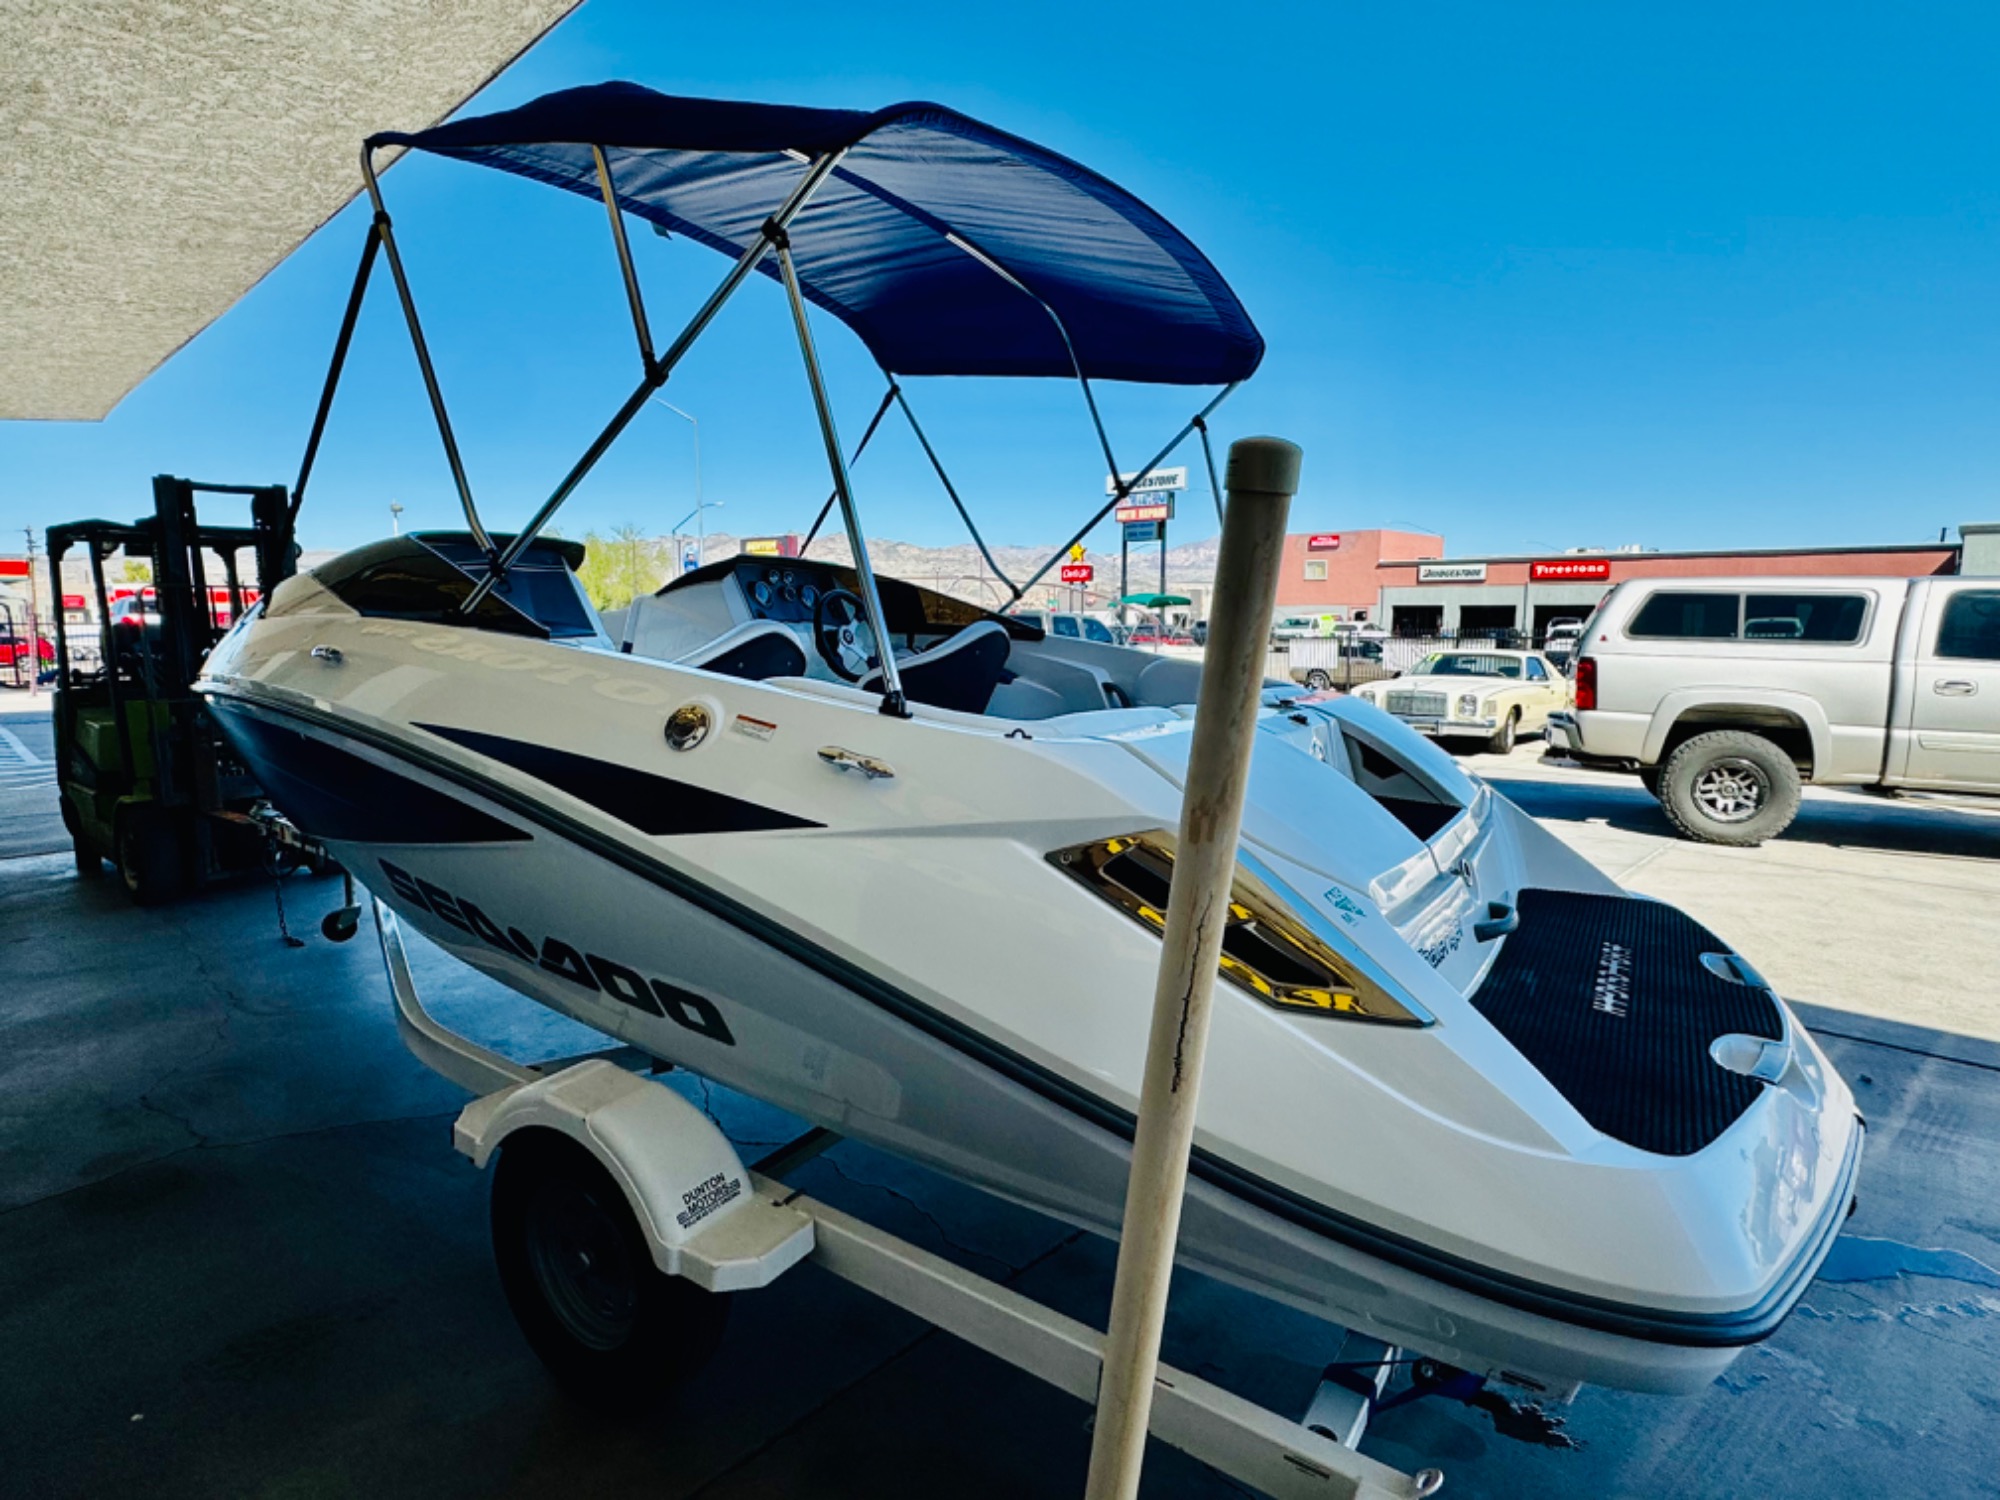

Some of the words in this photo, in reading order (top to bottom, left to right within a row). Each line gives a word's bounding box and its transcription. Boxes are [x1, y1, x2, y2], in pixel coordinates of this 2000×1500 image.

[1535, 564, 1606, 577] Firestone
[682, 1172, 725, 1205] DUNTON
[687, 1182, 729, 1213] MOTORS
